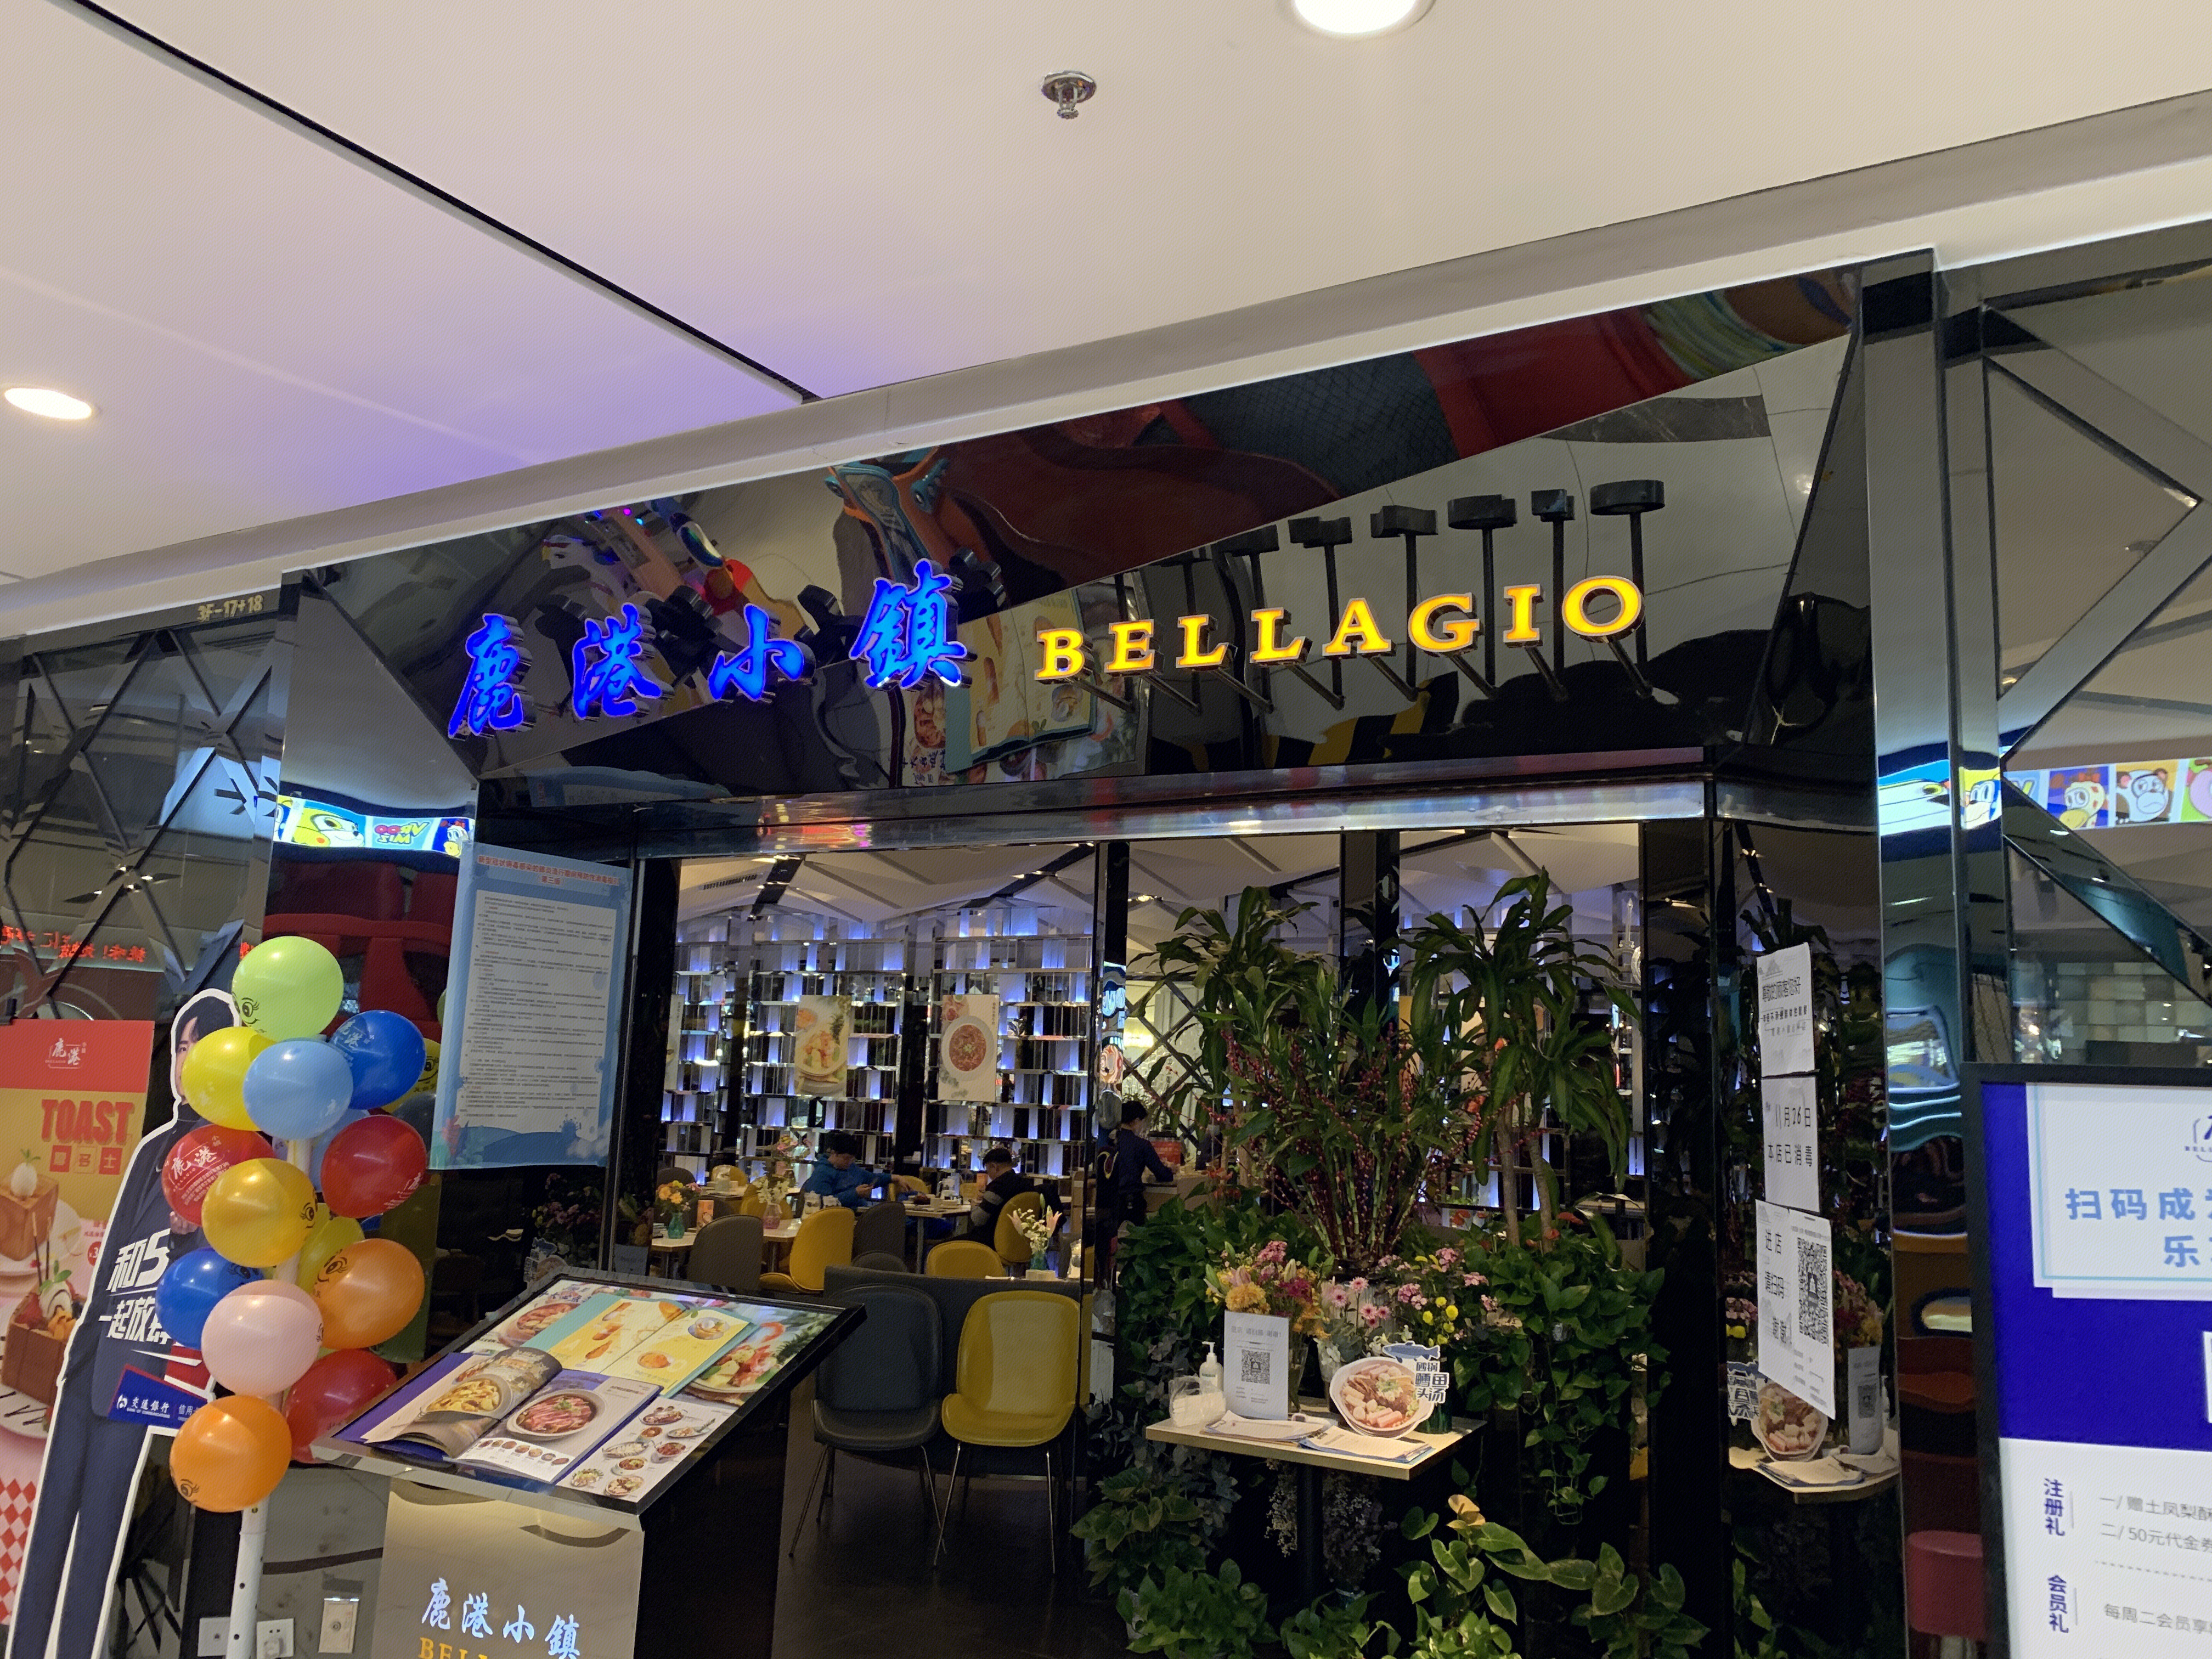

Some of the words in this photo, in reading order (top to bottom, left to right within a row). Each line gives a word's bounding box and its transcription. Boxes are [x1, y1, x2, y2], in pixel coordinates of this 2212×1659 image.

[197, 595, 263, 623] 3F-17+18
[448, 557, 968, 739] 鹿港小鎮
[1034, 574, 1646, 682] BELLAGIO
[41, 1099, 135, 1146] TOAST
[1768, 1142, 1813, 1167] 本店已消毒
[1765, 1228, 1782, 1255] 进店
[2163, 1235, 2212, 1268] 乐
[1772, 1316, 1787, 1344] 谢谢
[1415, 1373, 1448, 1388] 鳕鱼
[1416, 1362, 1438, 1372] 砂锅
[131, 1397, 170, 1414] 交通銀行
[1417, 1387, 1444, 1402] 头汤
[2044, 1477, 2066, 1537] 注册礼
[2047, 1575, 2069, 1634] 会员礼
[2104, 1603, 2212, 1635] 每周二会员享
[418, 1637, 489, 1659] BE
